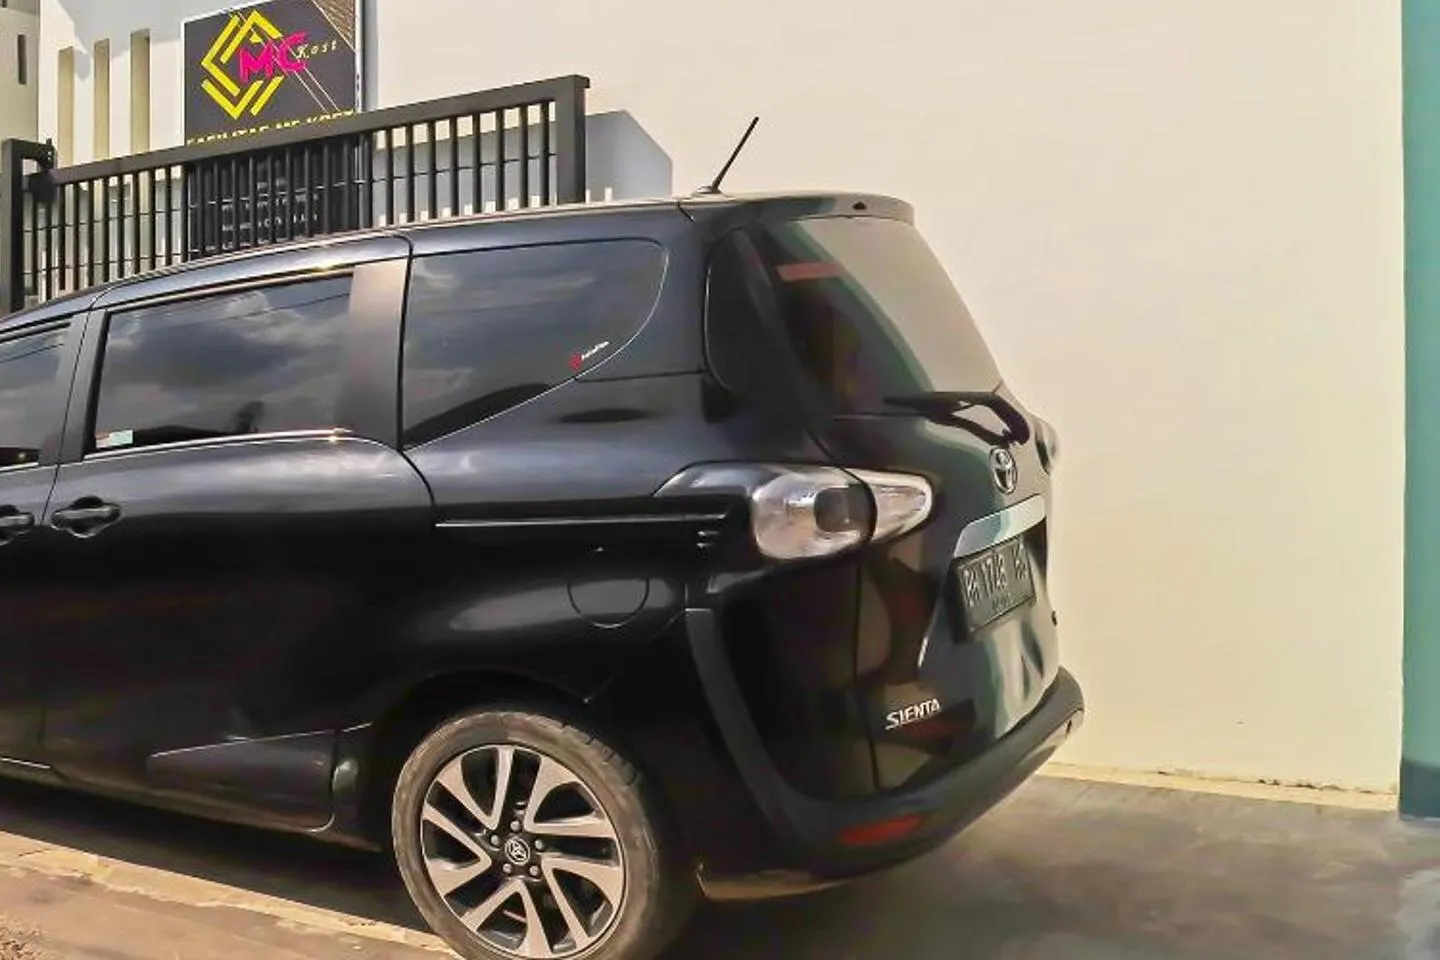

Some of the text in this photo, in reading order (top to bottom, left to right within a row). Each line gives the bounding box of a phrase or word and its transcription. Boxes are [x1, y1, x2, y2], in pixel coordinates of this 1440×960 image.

[239, 30, 337, 84] MC Kost
[885, 698, 941, 731] SIENTA
